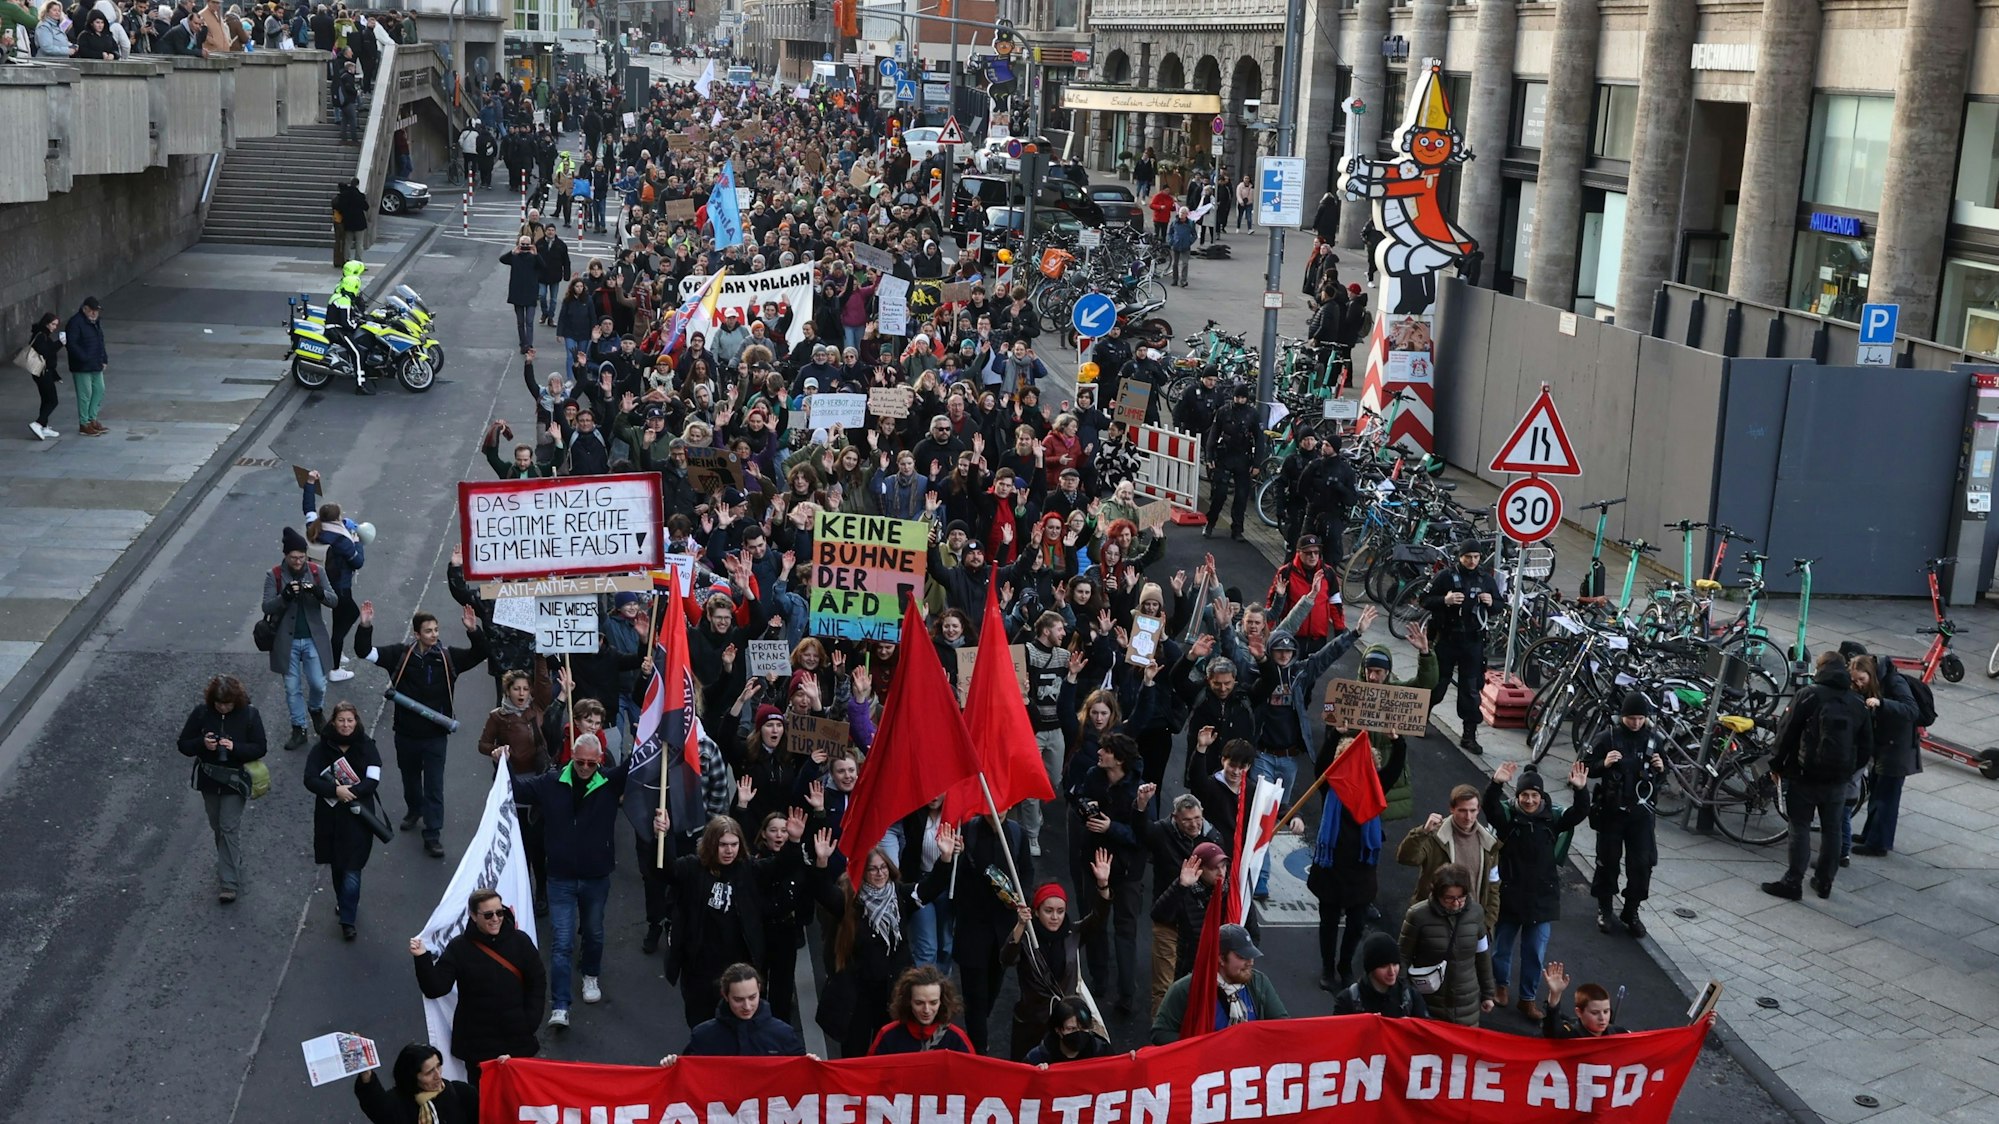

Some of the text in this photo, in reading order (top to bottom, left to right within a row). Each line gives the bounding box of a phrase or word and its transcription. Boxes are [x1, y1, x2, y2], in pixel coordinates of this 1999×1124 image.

[1110, 96, 1192, 108] Excelsior Hotel Ernst
[1810, 212, 1856, 237] MILLENIA
[683, 271, 810, 294] YAAH YALLAH
[1867, 309, 1889, 339] P
[300, 341, 325, 354] POLIZEI
[477, 486, 613, 512] DAS EINZIG
[1509, 496, 1549, 526] 30
[476, 508, 629, 538] LEGITIME RECHTE
[821, 514, 903, 544] KEINE
[820, 541, 916, 573] BÜHNE
[497, 581, 579, 597] ANTI-ANTIFA
[594, 578, 618, 592] FA
[817, 566, 868, 592] DER
[539, 602, 563, 617] NIE
[564, 601, 600, 617] WIEDER
[817, 590, 880, 616] AFD
[558, 619, 580, 630] IST
[818, 617, 902, 643] NIE WIE
[541, 630, 597, 648] JETZT
[751, 643, 789, 651] PROTECT
[751, 651, 786, 661] TRANS
[756, 663, 777, 671] KIDS
[1336, 682, 1419, 700] FASCHISTEN HÖREN
[1361, 700, 1376, 710] MAN
[1379, 699, 1424, 709] FASCHISTEN
[792, 715, 817, 732] KEIN
[1340, 707, 1356, 716] MIT
[1360, 709, 1381, 719] IHNEN
[1408, 715, 1424, 724] HAT
[1356, 718, 1396, 729] GESCHICHTE
[1397, 724, 1427, 732] GEZEIGT
[816, 738, 848, 761] NAZIS
[1190, 1054, 1387, 1124] GEGEN
[1405, 1053, 1506, 1103] DIE
